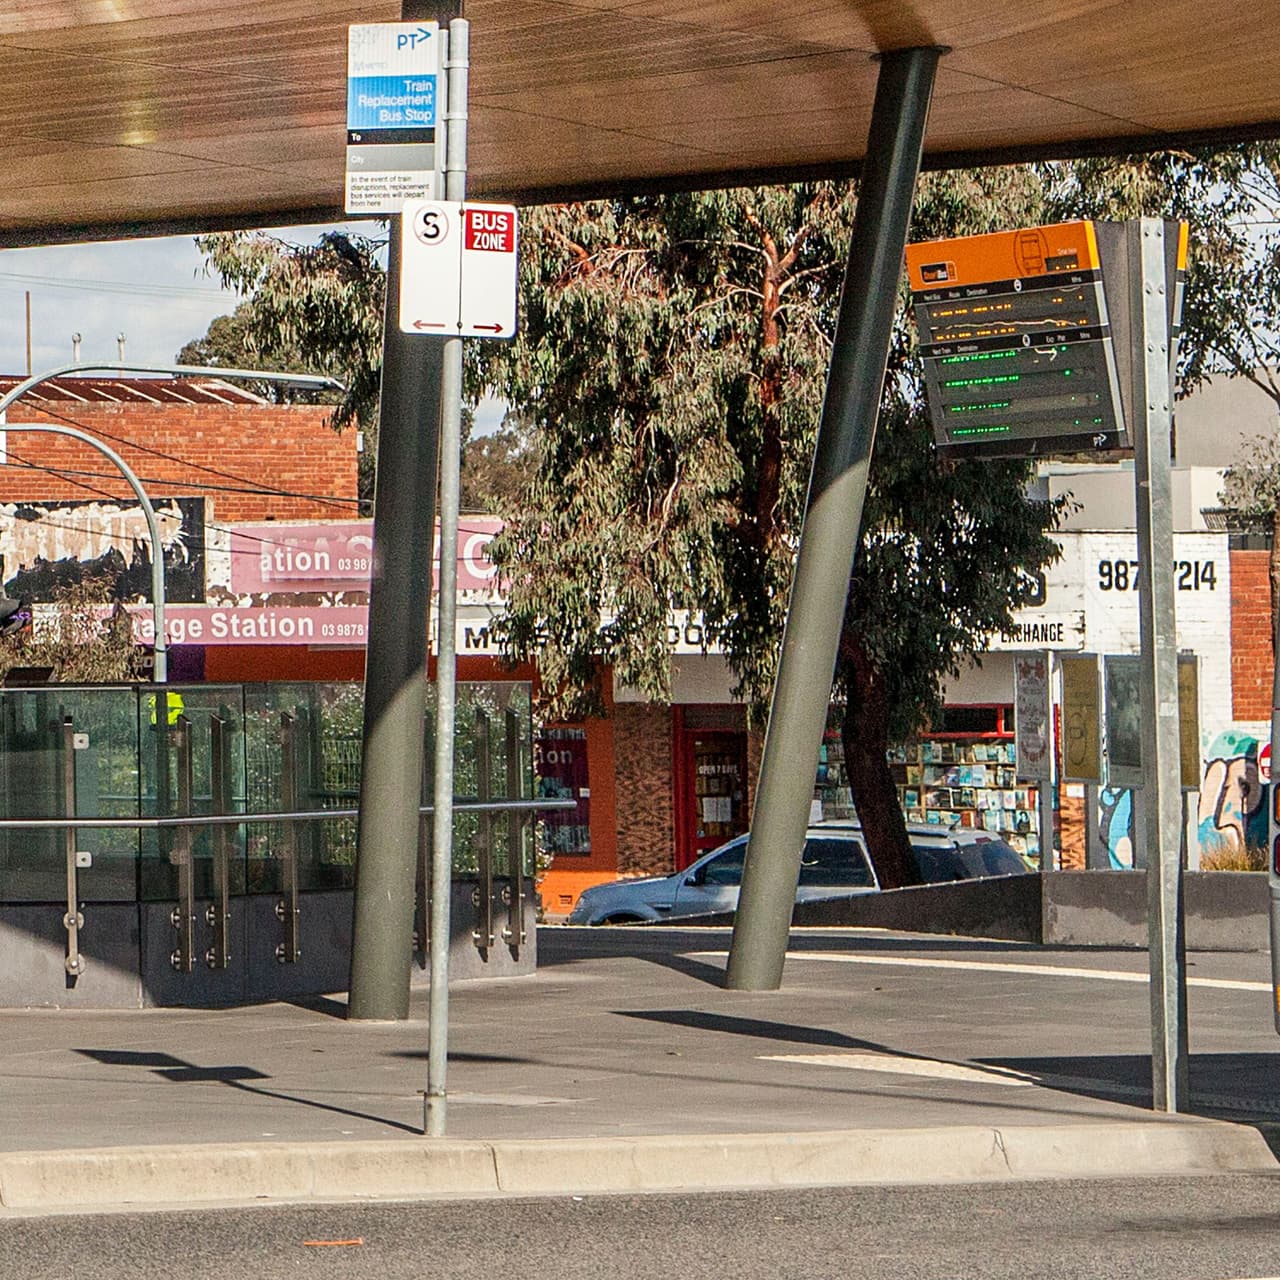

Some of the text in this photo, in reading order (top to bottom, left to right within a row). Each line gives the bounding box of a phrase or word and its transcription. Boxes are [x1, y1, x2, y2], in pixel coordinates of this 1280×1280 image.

[403, 80, 433, 92] Train
[358, 94, 432, 109] Replacement
[380, 108, 432, 124] Bus Stop
[351, 133, 362, 141] To
[472, 212, 508, 232] BUS
[473, 231, 507, 251] ZONE
[338, 558, 352, 570] 03
[1098, 560, 1217, 591] 987 214
[210, 611, 314, 638] Station
[321, 623, 335, 636] 03
[336, 624, 365, 636] 9878
